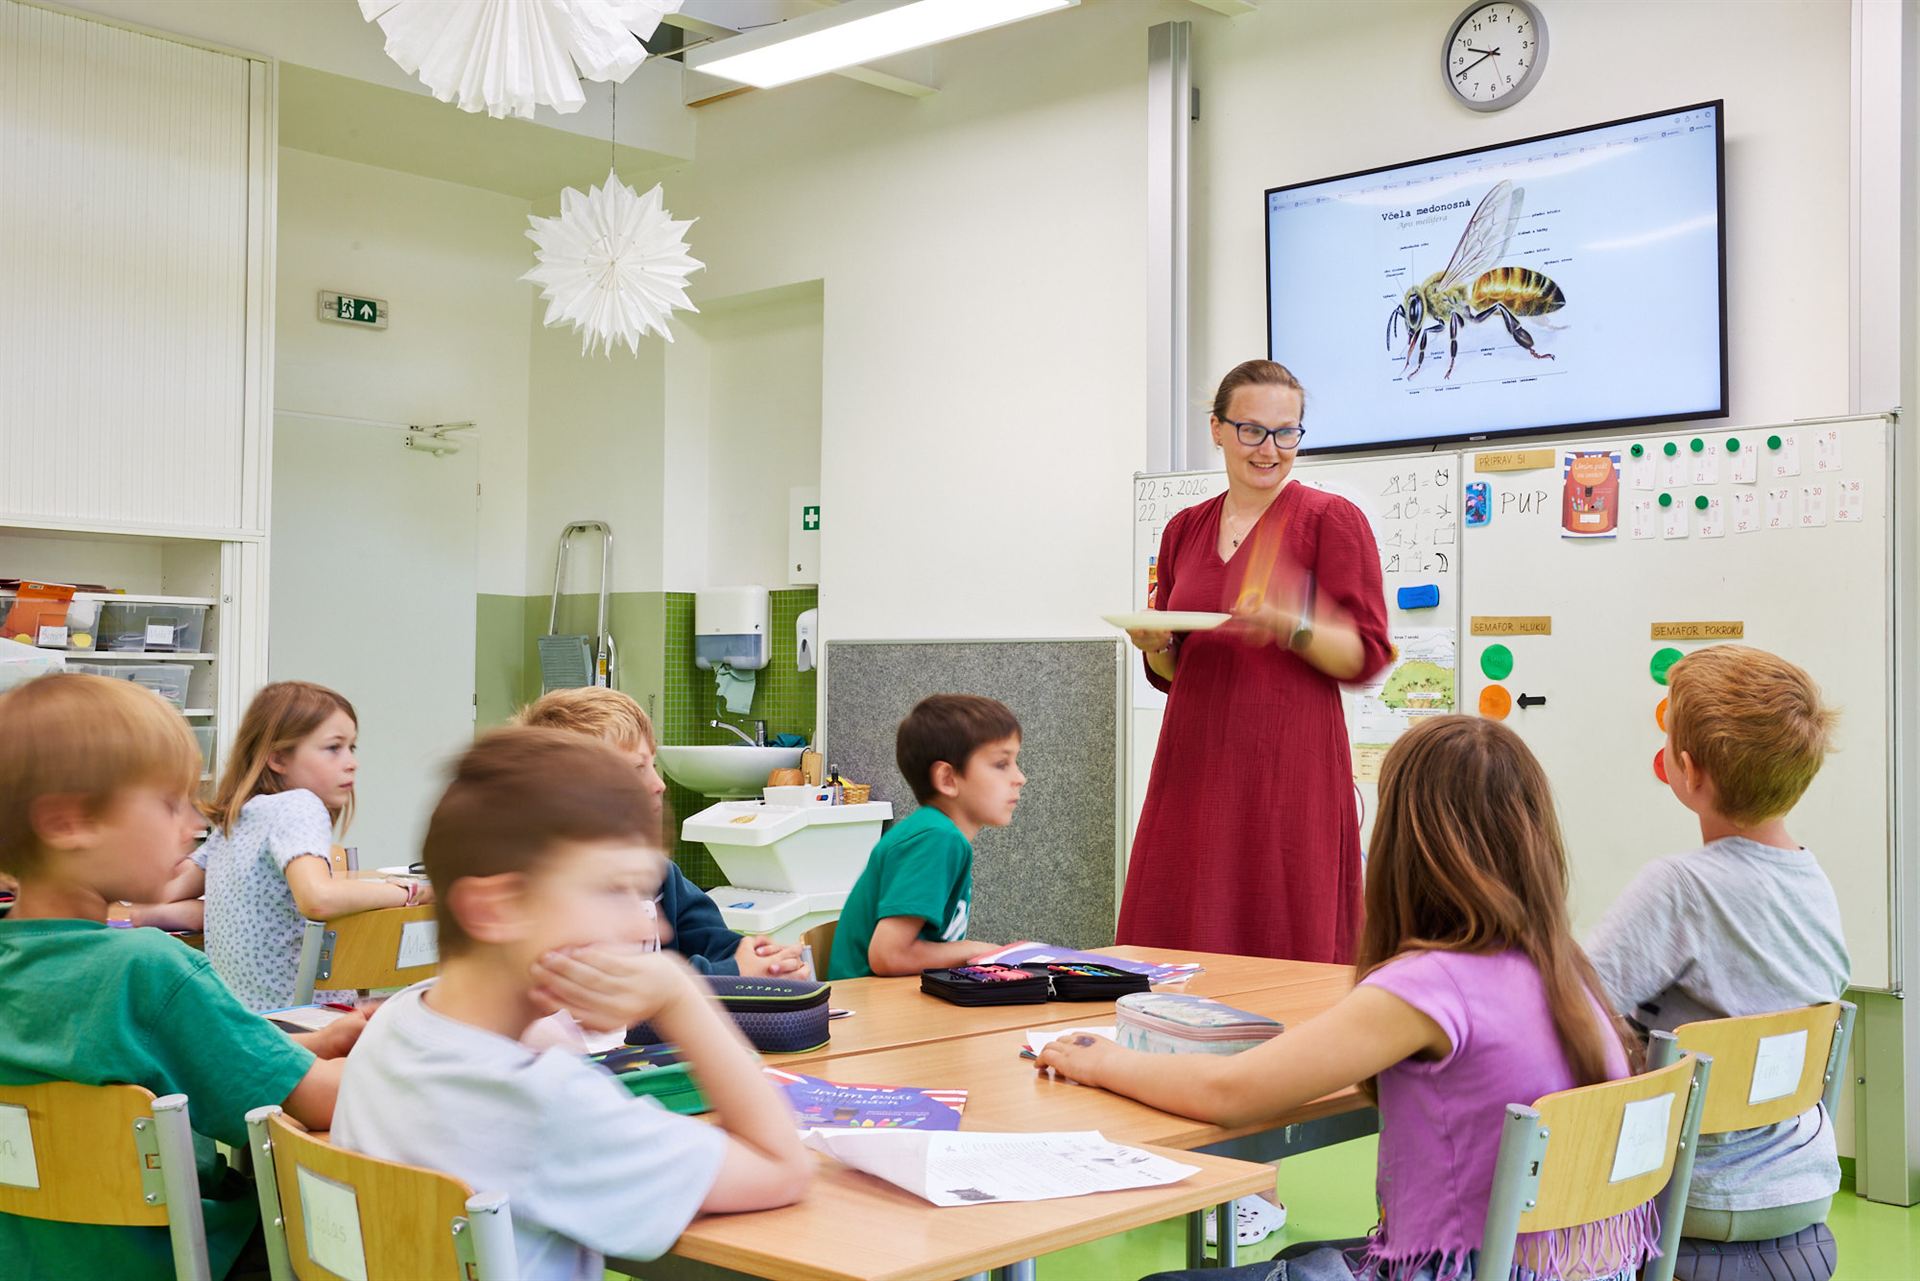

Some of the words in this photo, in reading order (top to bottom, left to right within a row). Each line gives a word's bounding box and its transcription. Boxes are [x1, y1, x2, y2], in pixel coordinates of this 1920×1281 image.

[1488, 14, 1498, 23] 12
[1473, 23, 1481, 31] 11
[1517, 25, 1523, 34] 2
[1462, 38, 1472, 47] 10
[1522, 41, 1528, 49] 3
[1458, 57, 1464, 65] 9
[1518, 58, 1523, 66] 4
[1462, 72, 1468, 80] 8
[1506, 75, 1511, 83] 5
[1474, 82, 1479, 90] 7
[1490, 83, 1496, 92] 6
[1381, 209, 1411, 221] Včela
[1416, 198, 1471, 215] medonosná
[1828, 432, 1837, 440] 16
[1501, 490, 1548, 514] PUP
[1474, 622, 1514, 632] SEMAFOR
[1519, 622, 1547, 632] HLUKU
[1654, 626, 1700, 636] SEMAFOR
[1705, 625, 1744, 635] POKROKU
[735, 984, 792, 993] OXYBAG
